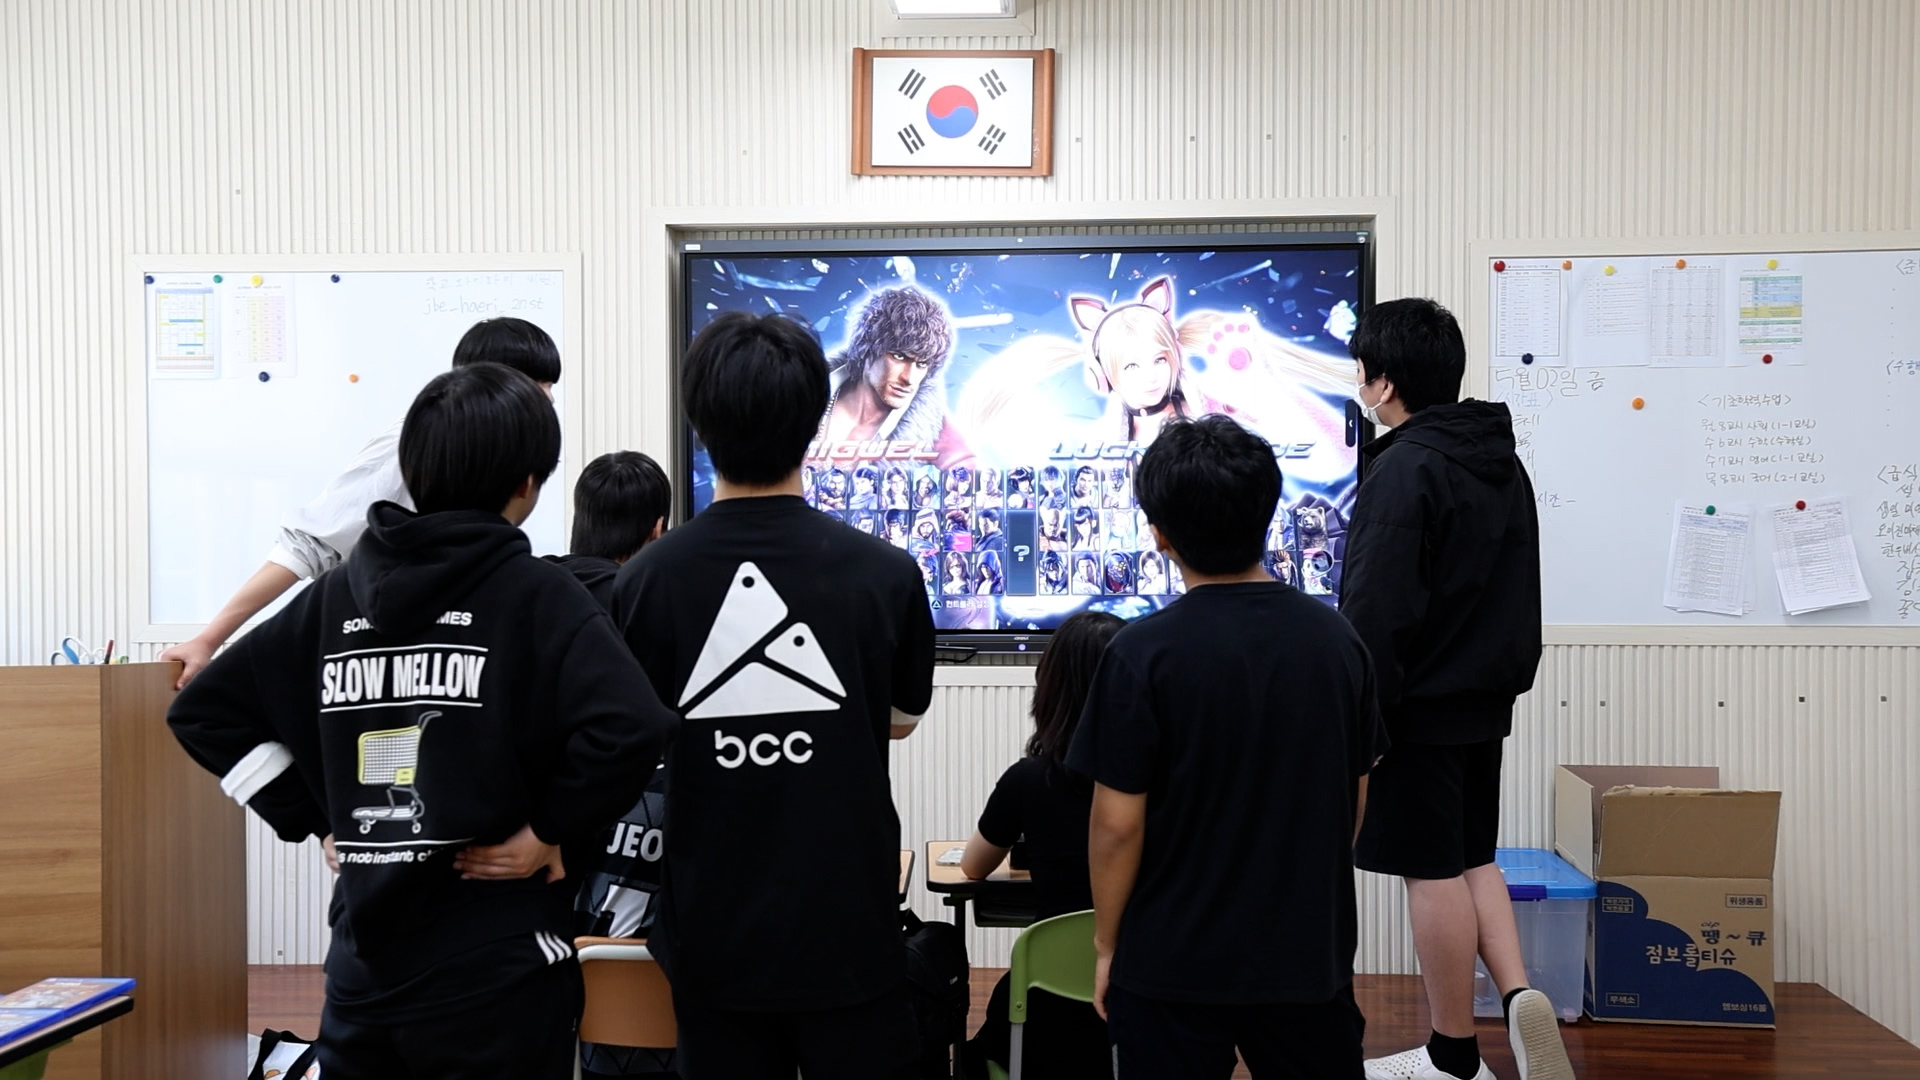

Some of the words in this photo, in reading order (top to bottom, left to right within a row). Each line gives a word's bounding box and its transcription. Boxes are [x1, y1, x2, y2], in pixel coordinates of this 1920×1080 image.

[1587, 371, 1606, 391] 금
[321, 656, 387, 705] SLOW
[392, 652, 486, 699] MELLOW
[714, 729, 813, 769] bcc
[346, 851, 373, 864] not
